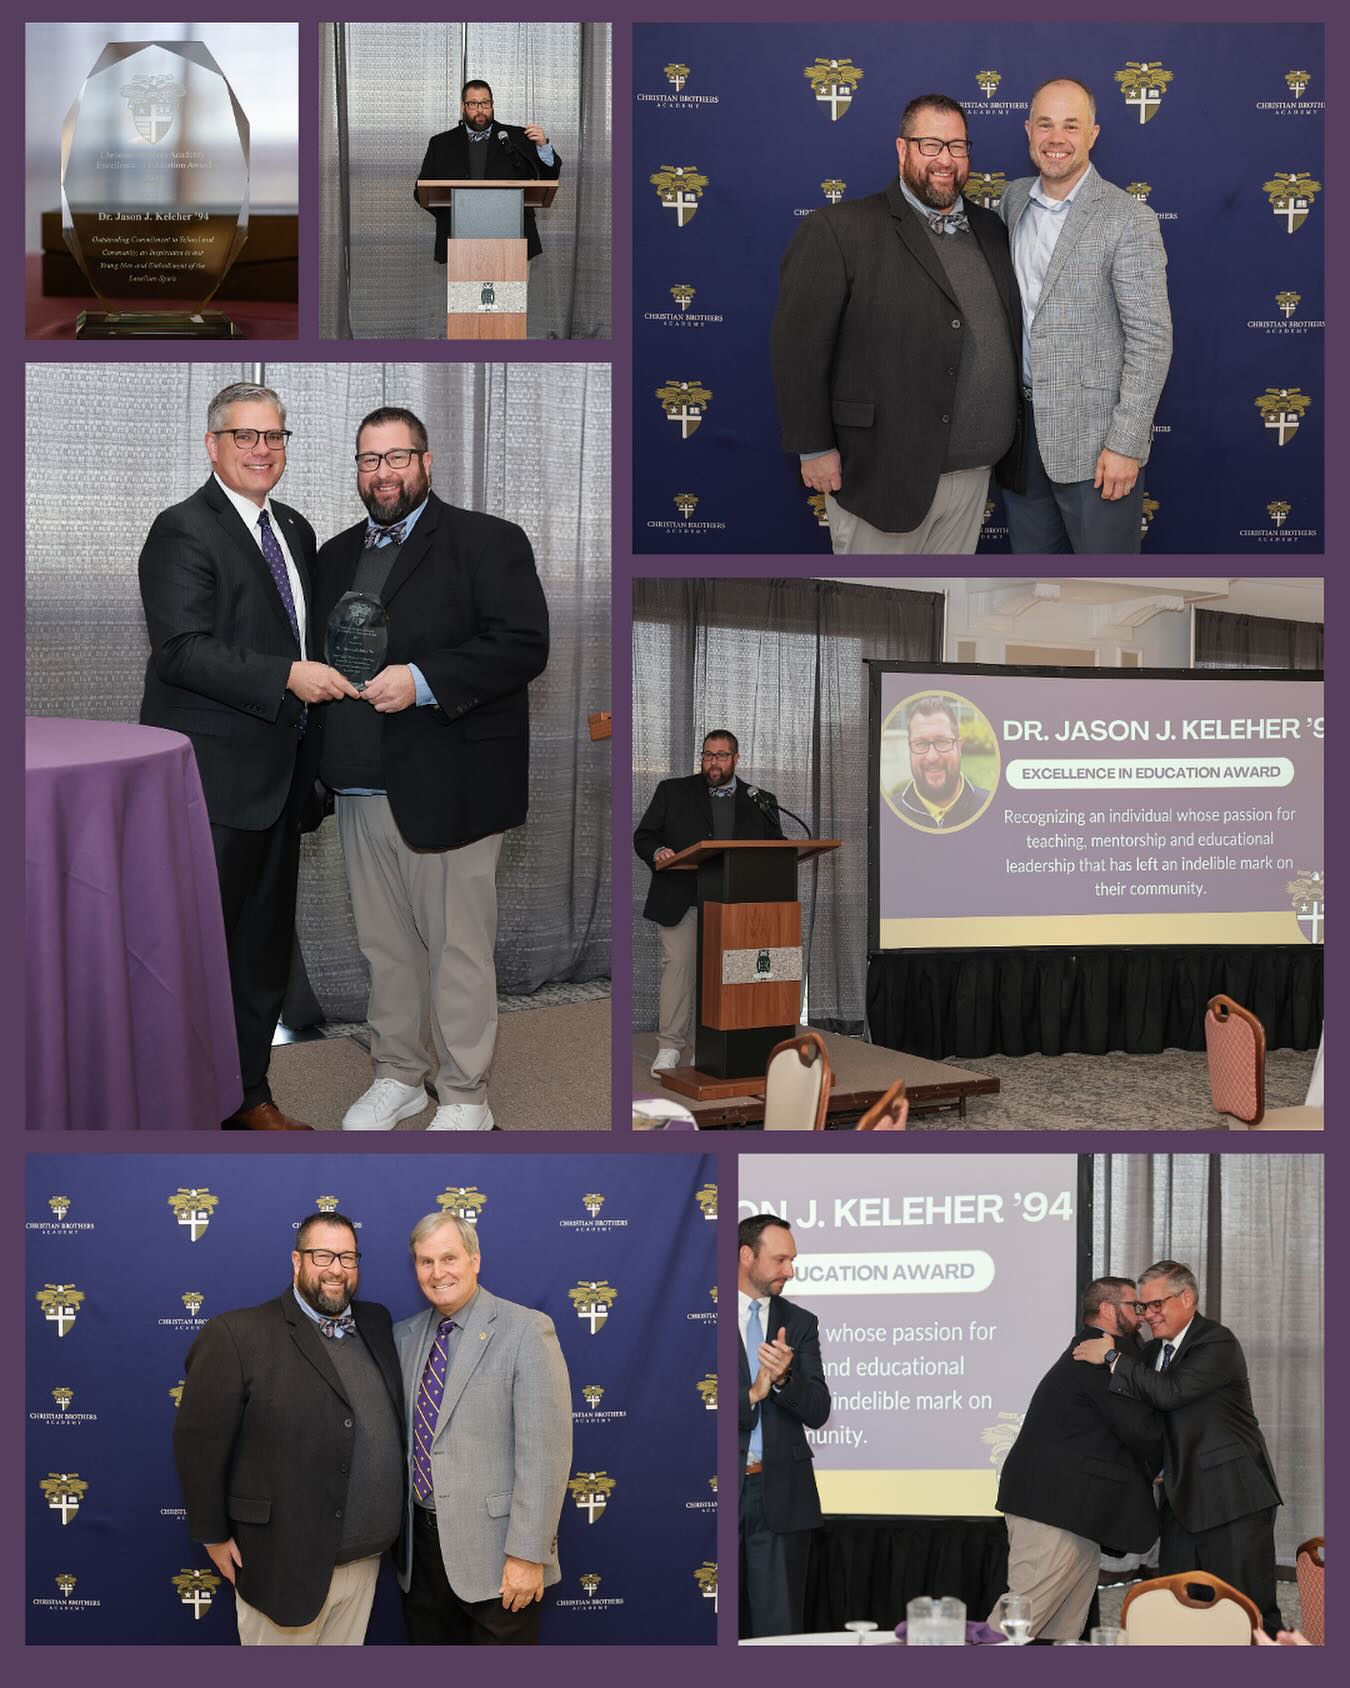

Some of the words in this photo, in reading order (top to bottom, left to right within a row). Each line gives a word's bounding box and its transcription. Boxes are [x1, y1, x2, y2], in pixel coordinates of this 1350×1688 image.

[637, 93, 678, 102] CHRISTIAN
[679, 94, 719, 103] BROTHERS
[990, 101, 1029, 109] BROTHERS
[98, 212, 113, 221] Dr.
[115, 212, 142, 221] Jason
[144, 212, 152, 221] J.
[156, 212, 192, 221] Keleher
[179, 235, 201, 243] School
[187, 262, 196, 270] of
[1003, 719, 1049, 742] DR.
[1055, 719, 1150, 742] JASON
[1155, 719, 1176, 741] J.
[1183, 718, 1300, 740] KELEHER
[1306, 718, 1324, 738] '9
[1022, 767, 1115, 780] EXCELLENCE
[1118, 767, 1132, 779] IN
[1136, 766, 1220, 779] EDUCATION
[1223, 765, 1281, 778] AWARD
[1003, 808, 1086, 826] Recognizing
[1089, 814, 1105, 823] an
[1108, 808, 1172, 823] individual
[1176, 808, 1220, 822] whose
[1223, 808, 1273, 826] passion
[1276, 807, 1296, 822] for
[1026, 833, 1086, 850] teaching,
[1091, 833, 1166, 849] mentorship
[1170, 833, 1194, 847] and
[1198, 832, 1274, 846] educational
[1006, 858, 1075, 875] leadership
[1079, 859, 1106, 872] that
[1109, 858, 1132, 872] has
[1136, 857, 1159, 871] left
[1162, 861, 1178, 871] an
[1182, 856, 1237, 871] indelible
[1240, 857, 1272, 870] mark
[1276, 860, 1294, 870] on
[1095, 882, 1126, 896] their
[1130, 881, 1207, 898] community.
[796, 1200, 825, 1228] J.
[834, 1195, 1003, 1228] KELEHER
[1013, 1191, 1073, 1222] '94
[795, 1264, 888, 1282] UCATION
[892, 1263, 974, 1281] AWARD
[826, 1322, 887, 1342] whose
[892, 1322, 963, 1346] passion
[969, 1321, 997, 1341] for
[820, 1358, 850, 1376] nd
[857, 1356, 964, 1375] educational
[833, 1390, 910, 1410] indelible
[916, 1390, 962, 1409] mark
[968, 1396, 992, 1409] on
